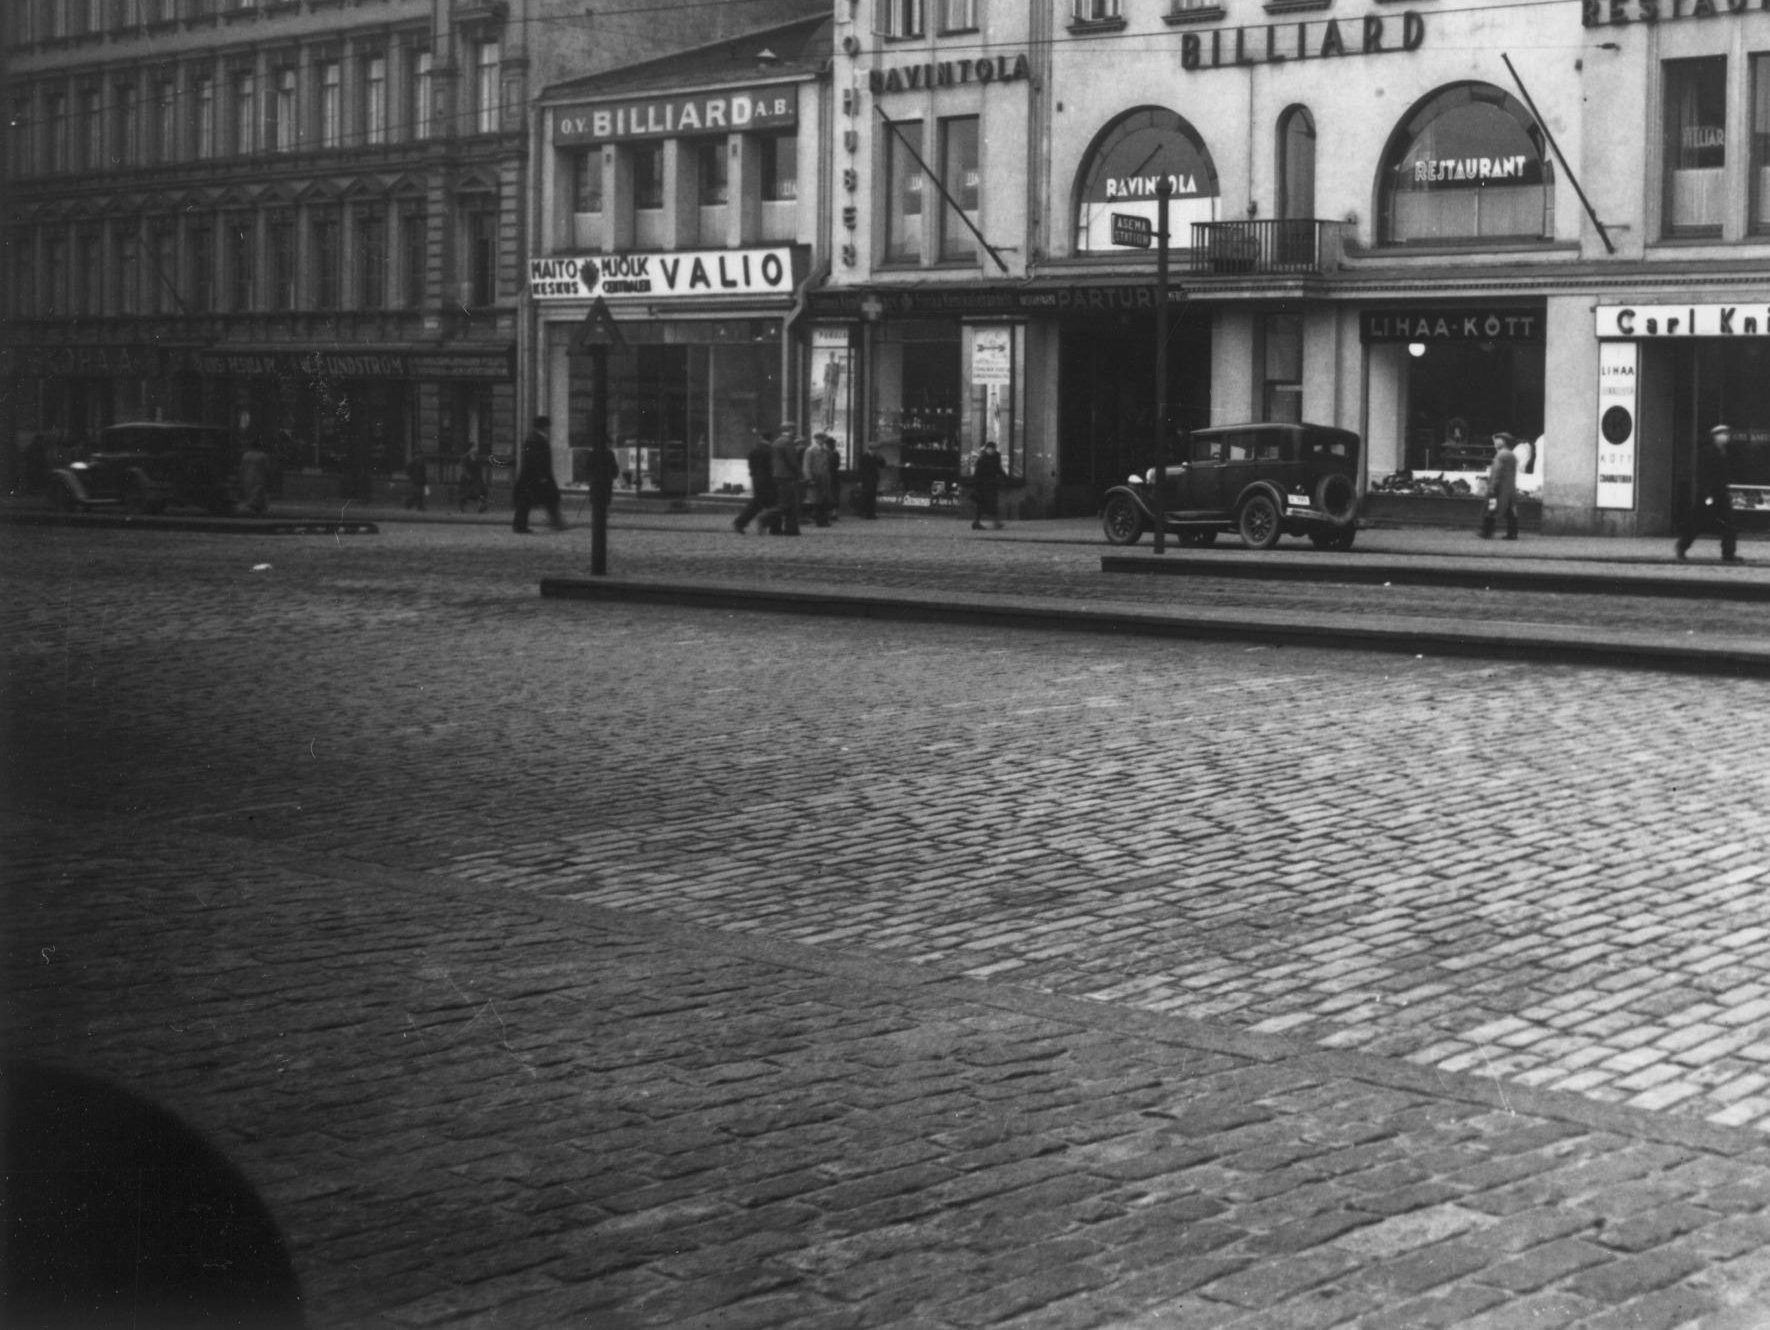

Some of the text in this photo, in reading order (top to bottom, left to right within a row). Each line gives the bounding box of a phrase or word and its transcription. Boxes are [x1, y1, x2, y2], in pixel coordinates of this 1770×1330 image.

[1182, 11, 1426, 69] BILLIARD
[869, 53, 1030, 95] RAVINTOLA
[561, 96, 794, 137] O.Y. BILLIARD A.B.
[842, 88, 859, 268] HUBER
[1415, 155, 1526, 181] RESTAURANT
[1106, 174, 1197, 197] RAVINOLA
[1117, 217, 1147, 232] ASEMA
[1114, 230, 1149, 245] STATION
[533, 259, 579, 280] MAITO
[661, 253, 784, 290] VALIO
[534, 281, 580, 296] KESKUS
[1370, 317, 1450, 337] LIHAA
[1617, 308, 1695, 335] Carl
[1602, 366, 1635, 376] LIHAA
